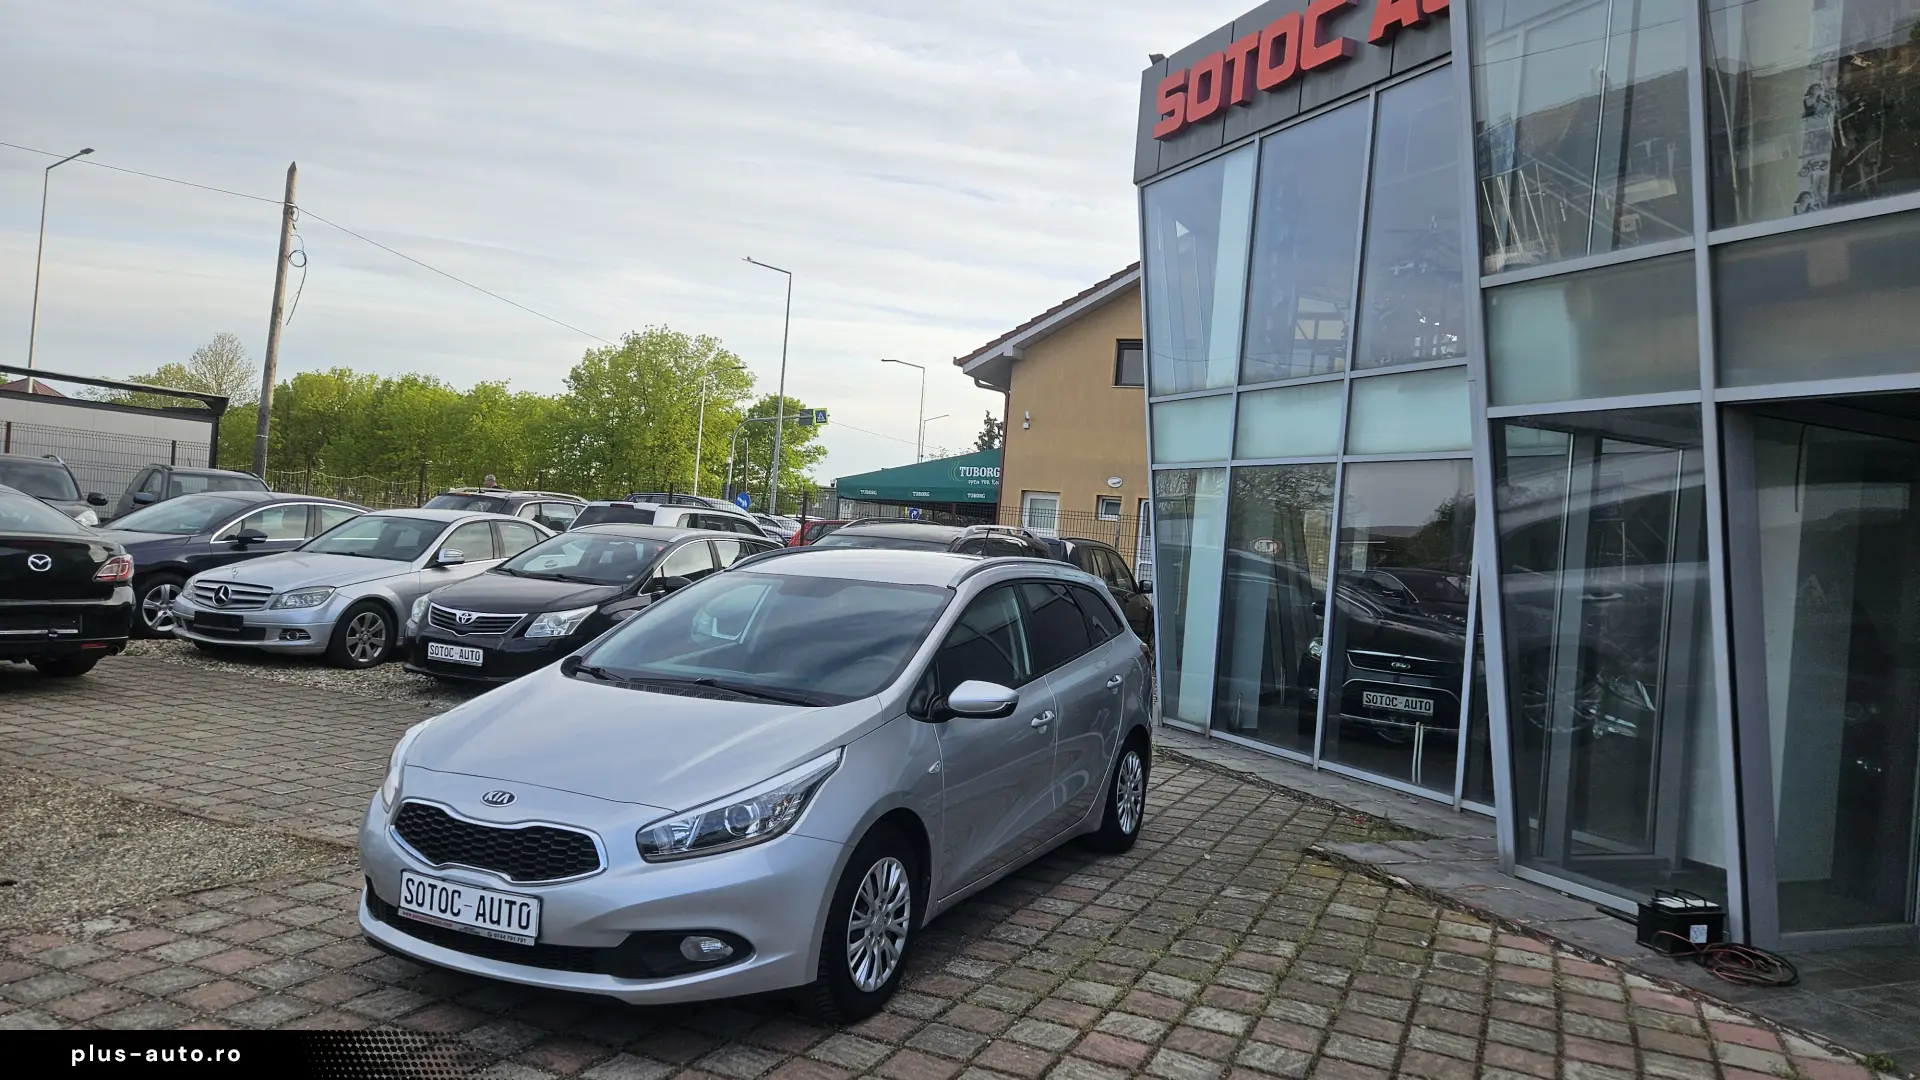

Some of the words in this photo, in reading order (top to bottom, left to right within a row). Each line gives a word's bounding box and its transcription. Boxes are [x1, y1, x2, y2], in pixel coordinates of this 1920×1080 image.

[1153, 0, 1351, 141] SOTOC
[959, 466, 1000, 478] TUBORG
[483, 790, 511, 804] KIA
